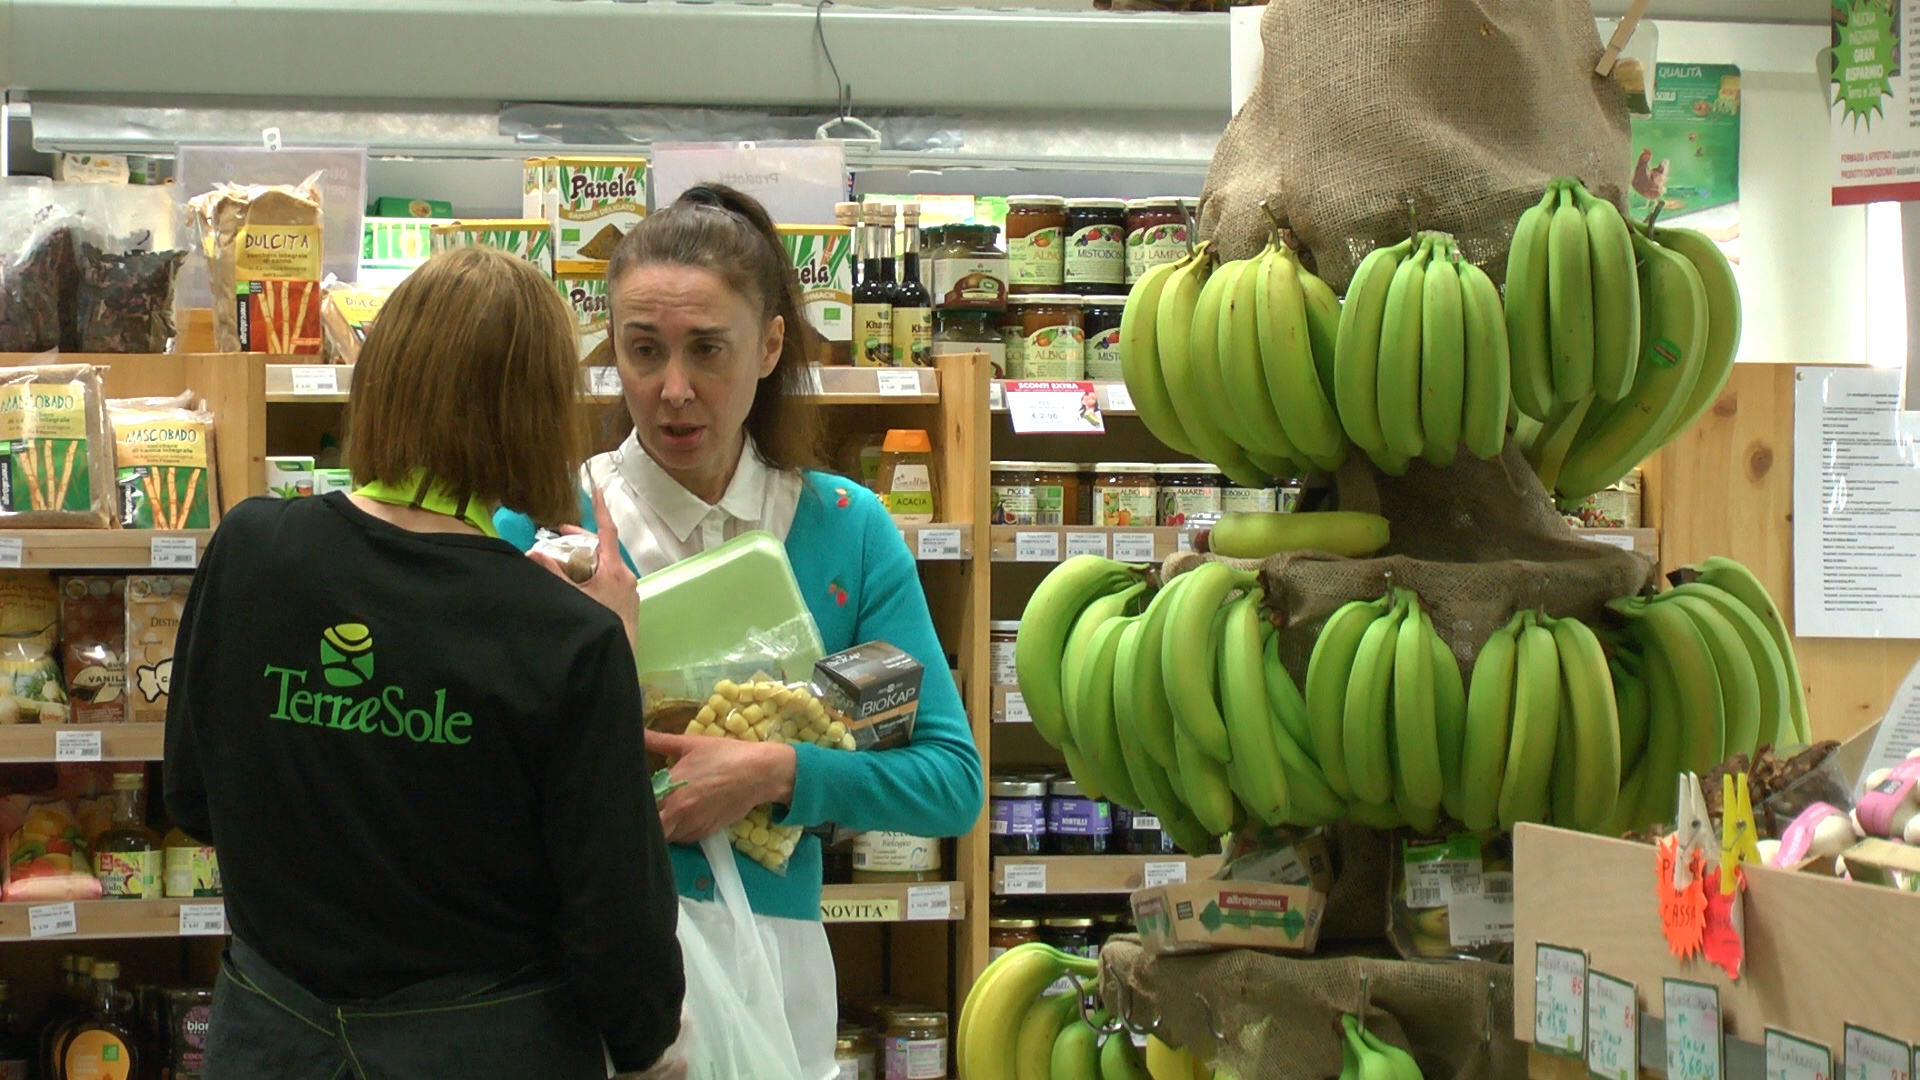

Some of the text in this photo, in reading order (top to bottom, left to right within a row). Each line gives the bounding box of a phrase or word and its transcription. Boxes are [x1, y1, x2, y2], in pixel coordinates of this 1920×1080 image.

[1853, 47, 1875, 63] GRAN
[1845, 64, 1884, 81] RISPARMIO
[570, 173, 637, 199] Panela
[569, 211, 599, 219] SAPORE
[245, 234, 309, 250] DULCITA
[126, 428, 197, 443] MASCOBADO
[896, 498, 927, 506] ACACIA
[861, 687, 916, 716] BIOKAP
[1664, 903, 1696, 927] CASSA
